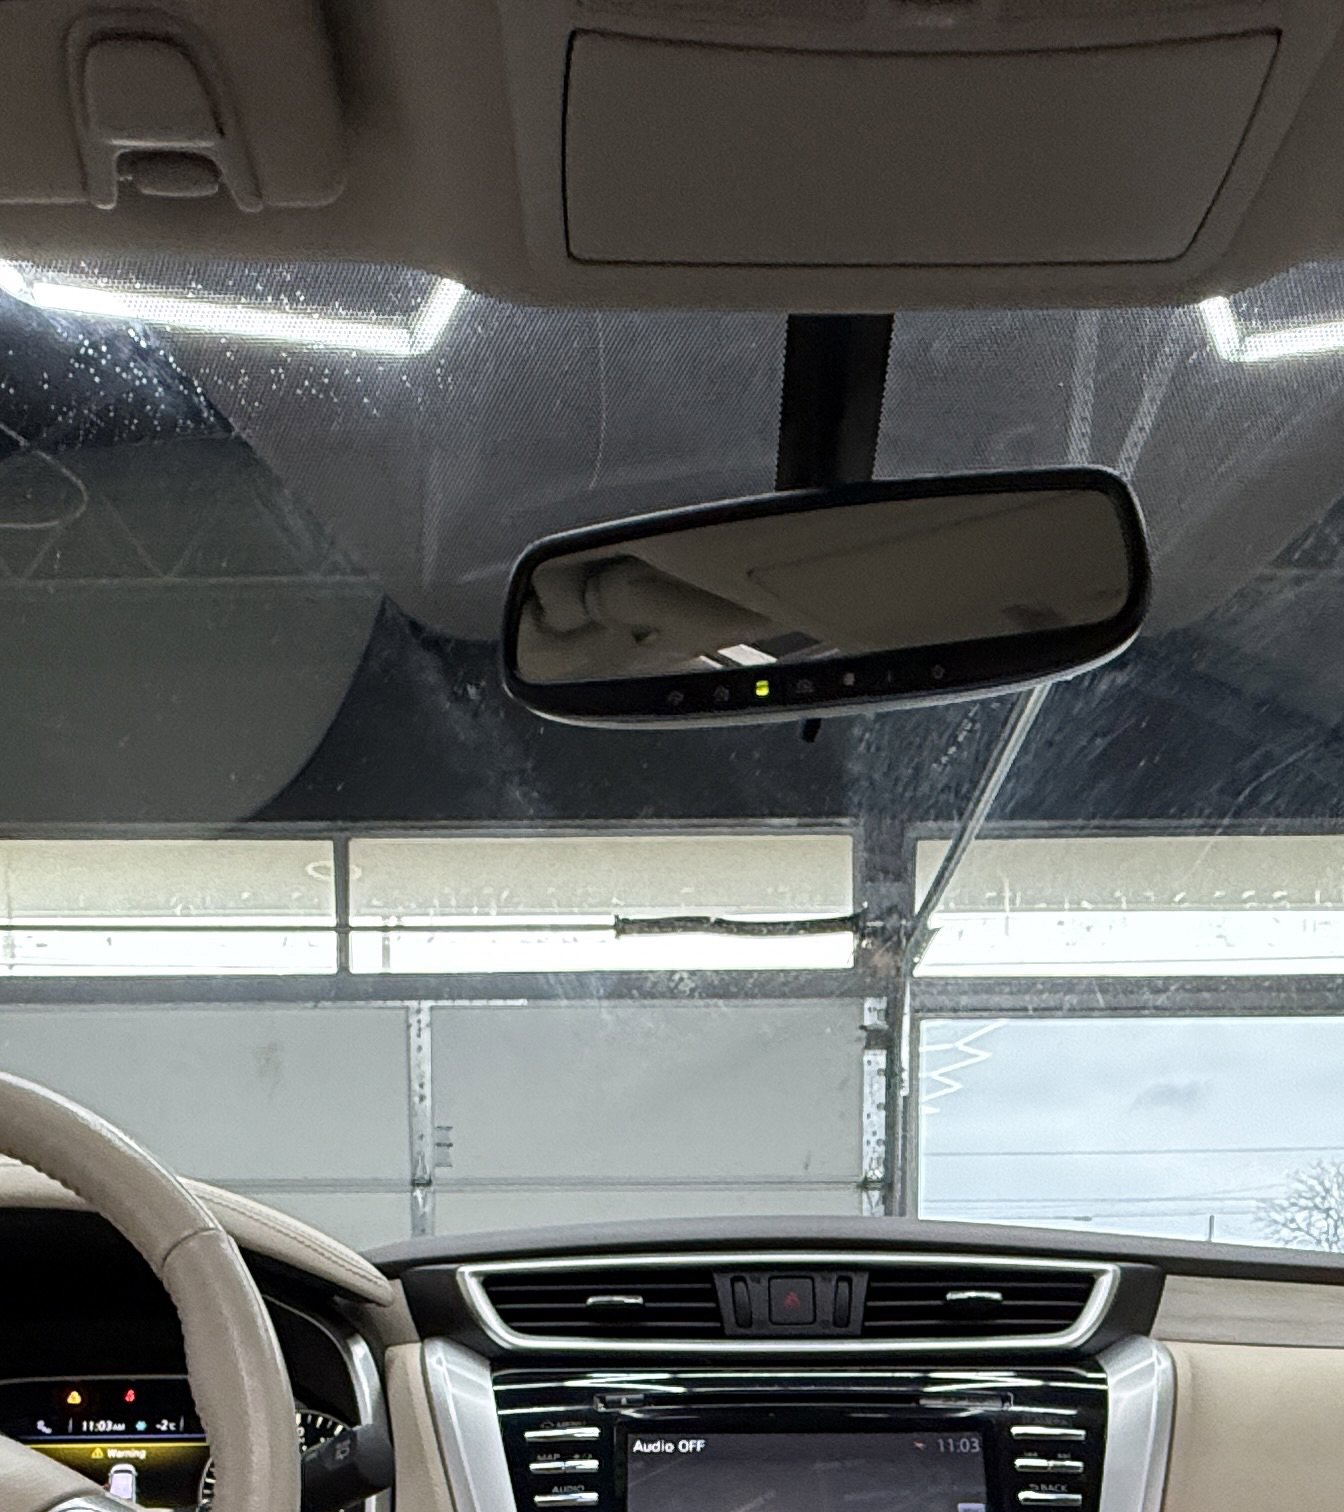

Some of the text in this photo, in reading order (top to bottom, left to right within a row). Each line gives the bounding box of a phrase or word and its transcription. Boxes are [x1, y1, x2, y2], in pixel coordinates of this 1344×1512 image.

[633, 1439, 706, 1453] Audio OFF
[938, 1438, 981, 1453] 11:03
[107, 1448, 147, 1460] Warning
[1040, 1483, 1068, 1492] BACK
